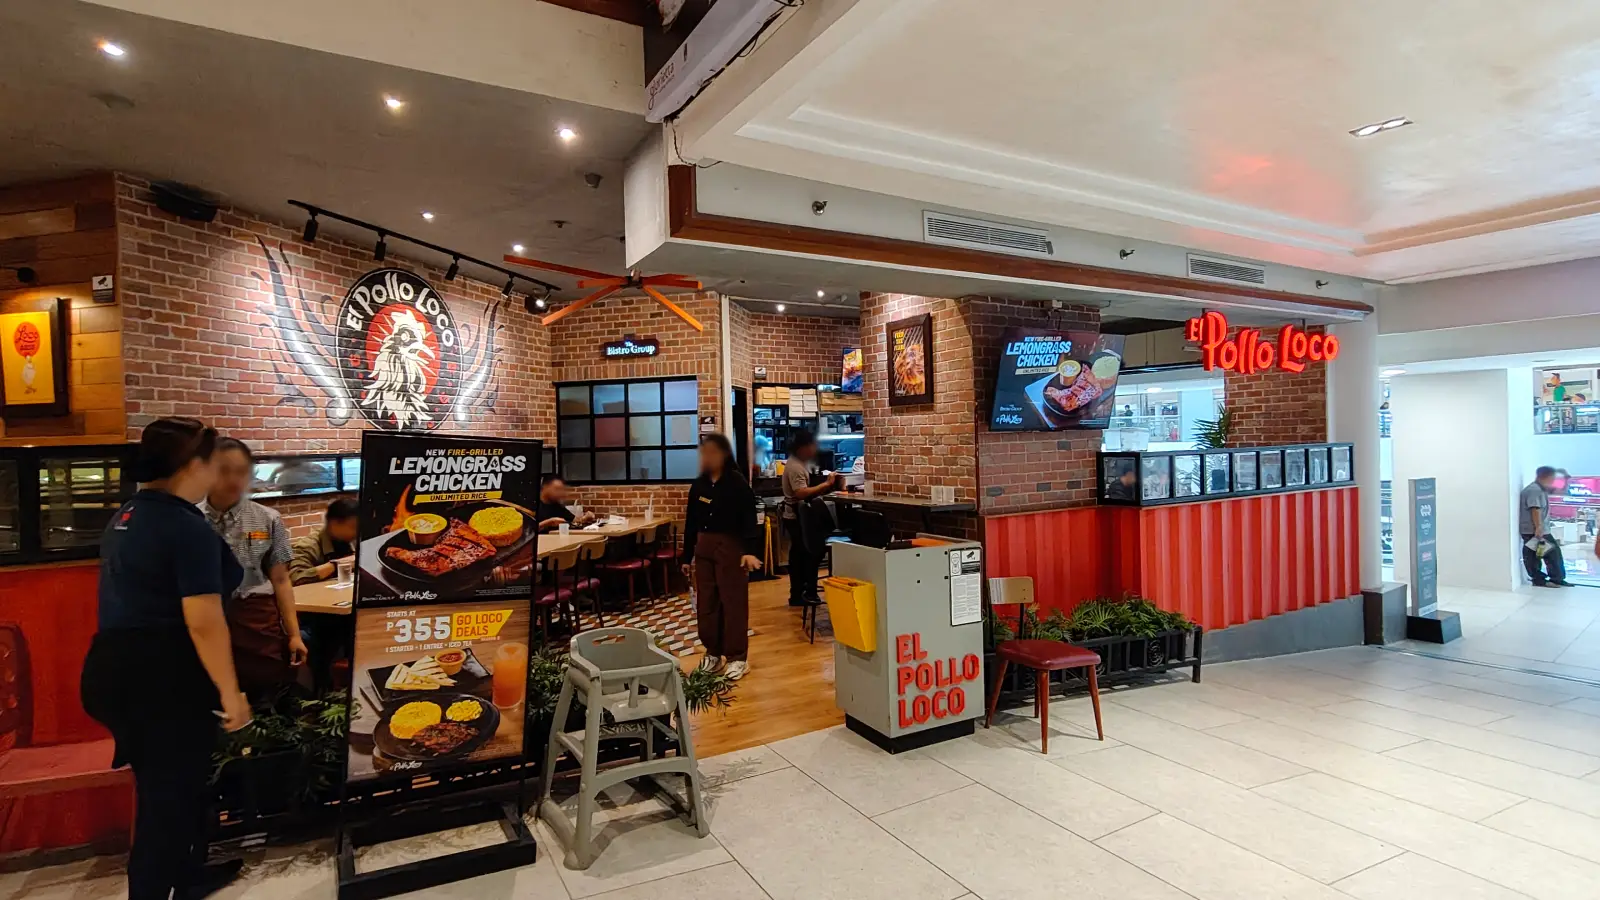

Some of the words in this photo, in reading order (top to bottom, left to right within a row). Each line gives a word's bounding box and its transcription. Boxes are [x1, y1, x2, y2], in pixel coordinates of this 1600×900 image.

[353, 272, 414, 316] Pollo
[346, 304, 364, 331] El
[415, 288, 454, 347] Loco
[606, 346, 630, 356] Bistro
[630, 345, 656, 355] Group
[1006, 341, 1072, 355] LEMONGRASS
[1202, 311, 1274, 375] Pollo
[1276, 324, 1340, 373] Loco
[1017, 354, 1059, 367] CHICKEN
[425, 449, 446, 457] NEW
[447, 448, 504, 456] FIRE-GRILLED
[389, 455, 527, 475] LEMONGRASS
[415, 473, 502, 492] CHICKEN
[430, 493, 470, 501] UNLIMITED
[471, 492, 488, 500] RICE
[404, 591, 421, 600] Pollo
[420, 590, 438, 600] Loco
[456, 614, 472, 626] GO
[475, 612, 503, 624] LOCO
[456, 625, 489, 638] DEALS
[389, 645, 414, 653] STARTER
[895, 632, 928, 664] EL
[897, 653, 980, 696] POLLO
[898, 686, 965, 729] LOCO
